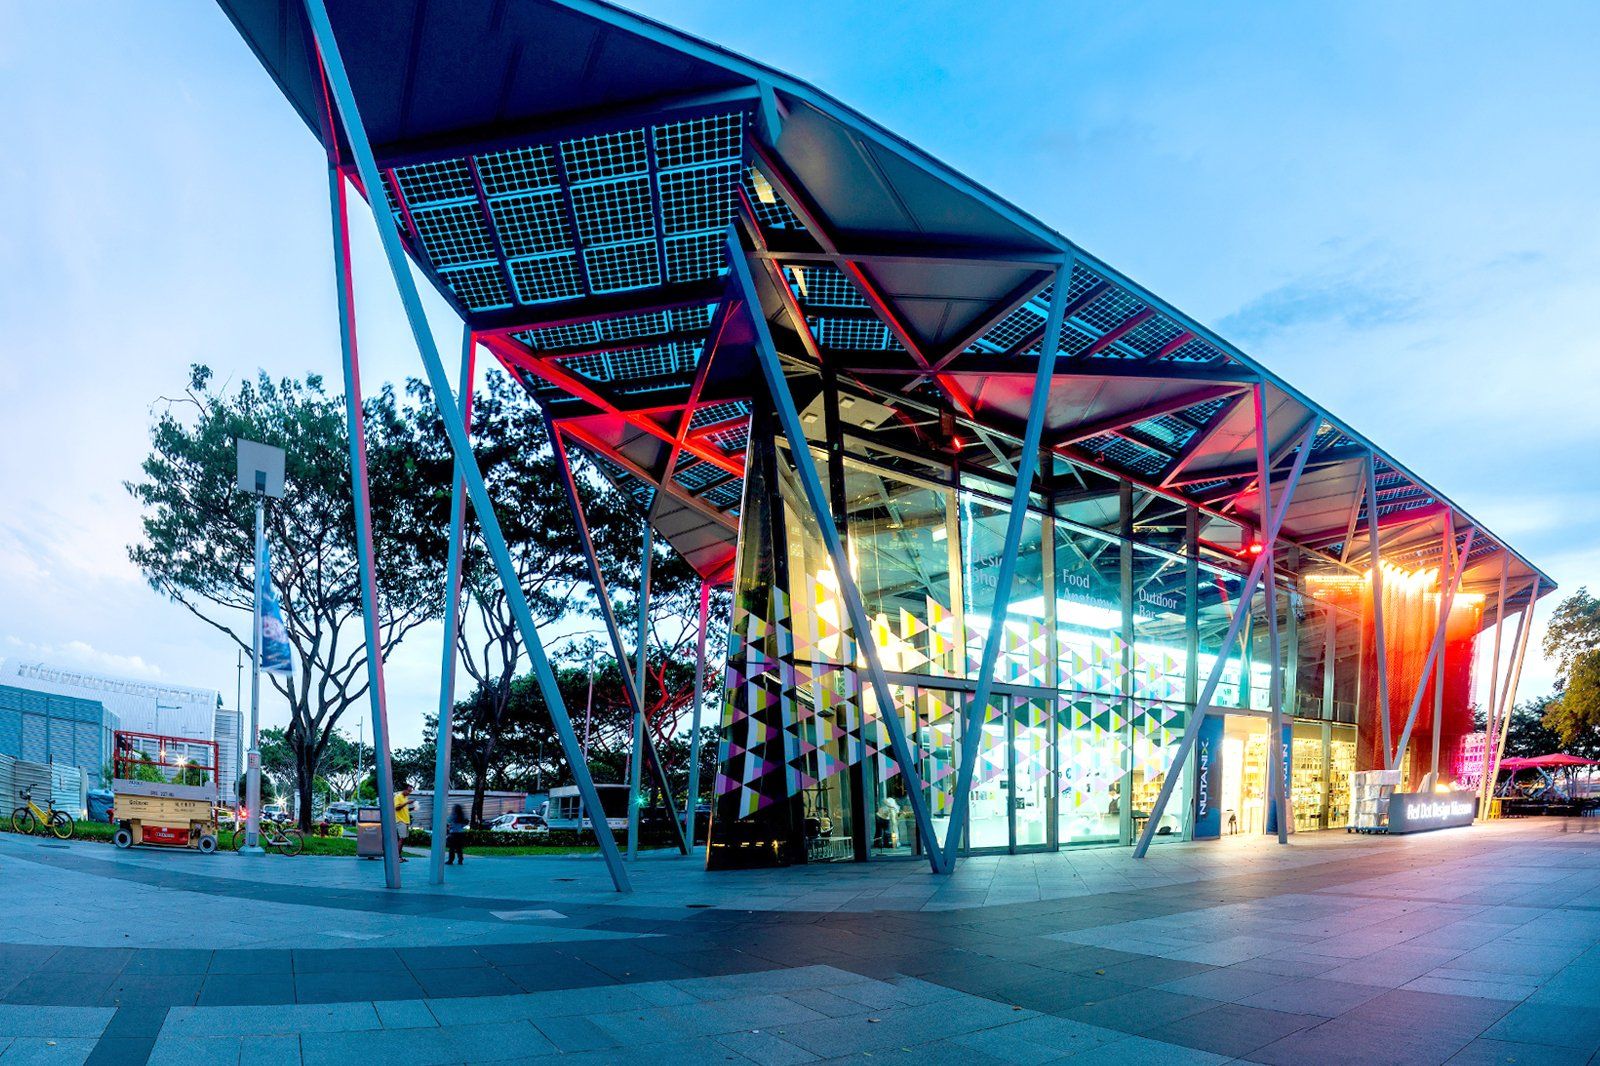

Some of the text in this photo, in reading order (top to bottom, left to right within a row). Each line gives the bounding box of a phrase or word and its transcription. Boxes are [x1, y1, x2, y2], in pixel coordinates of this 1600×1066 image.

[1063, 568, 1090, 589] Food
[1139, 588, 1177, 609] Outdoor
[1139, 604, 1156, 619] Bar
[1199, 740, 1209, 815] NUTANIX
